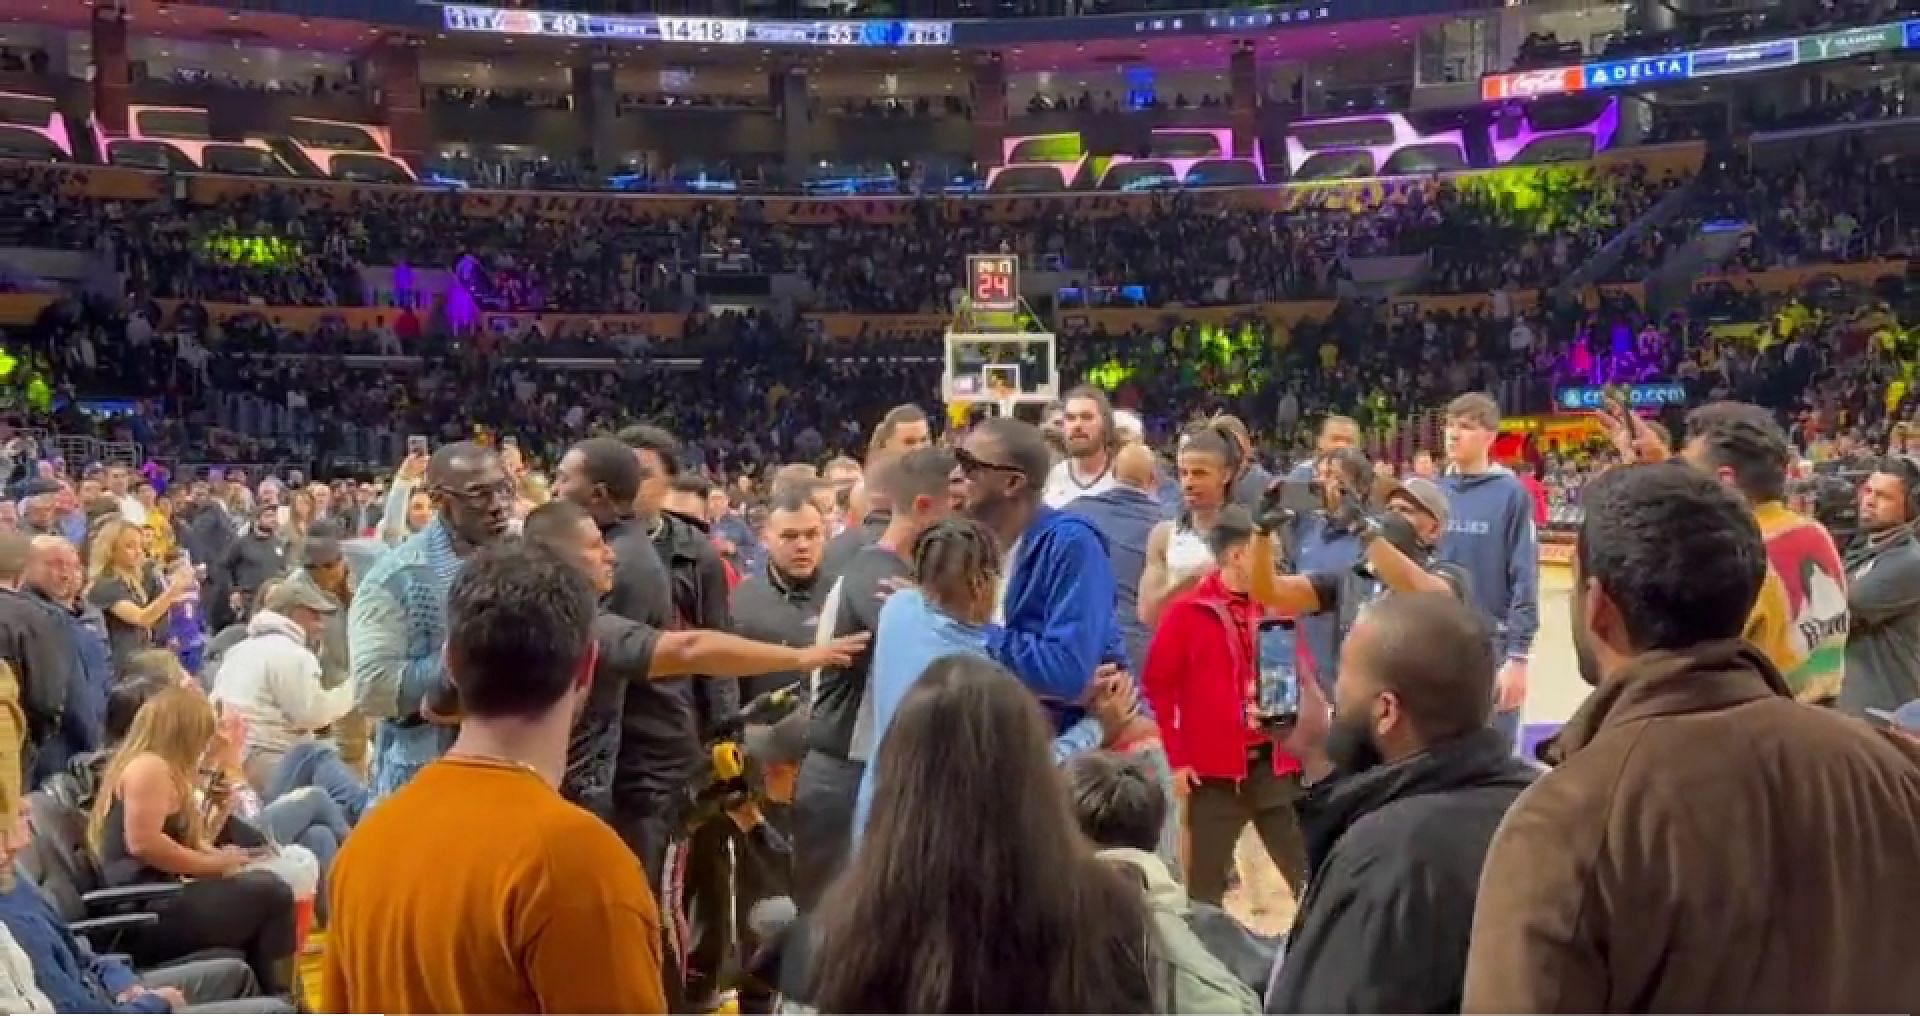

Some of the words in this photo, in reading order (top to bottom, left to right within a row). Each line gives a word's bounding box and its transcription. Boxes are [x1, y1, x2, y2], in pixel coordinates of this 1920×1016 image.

[1613, 60, 1682, 80] DELTA
[977, 273, 1009, 299] 24
[1583, 388, 1687, 403] cro.com
